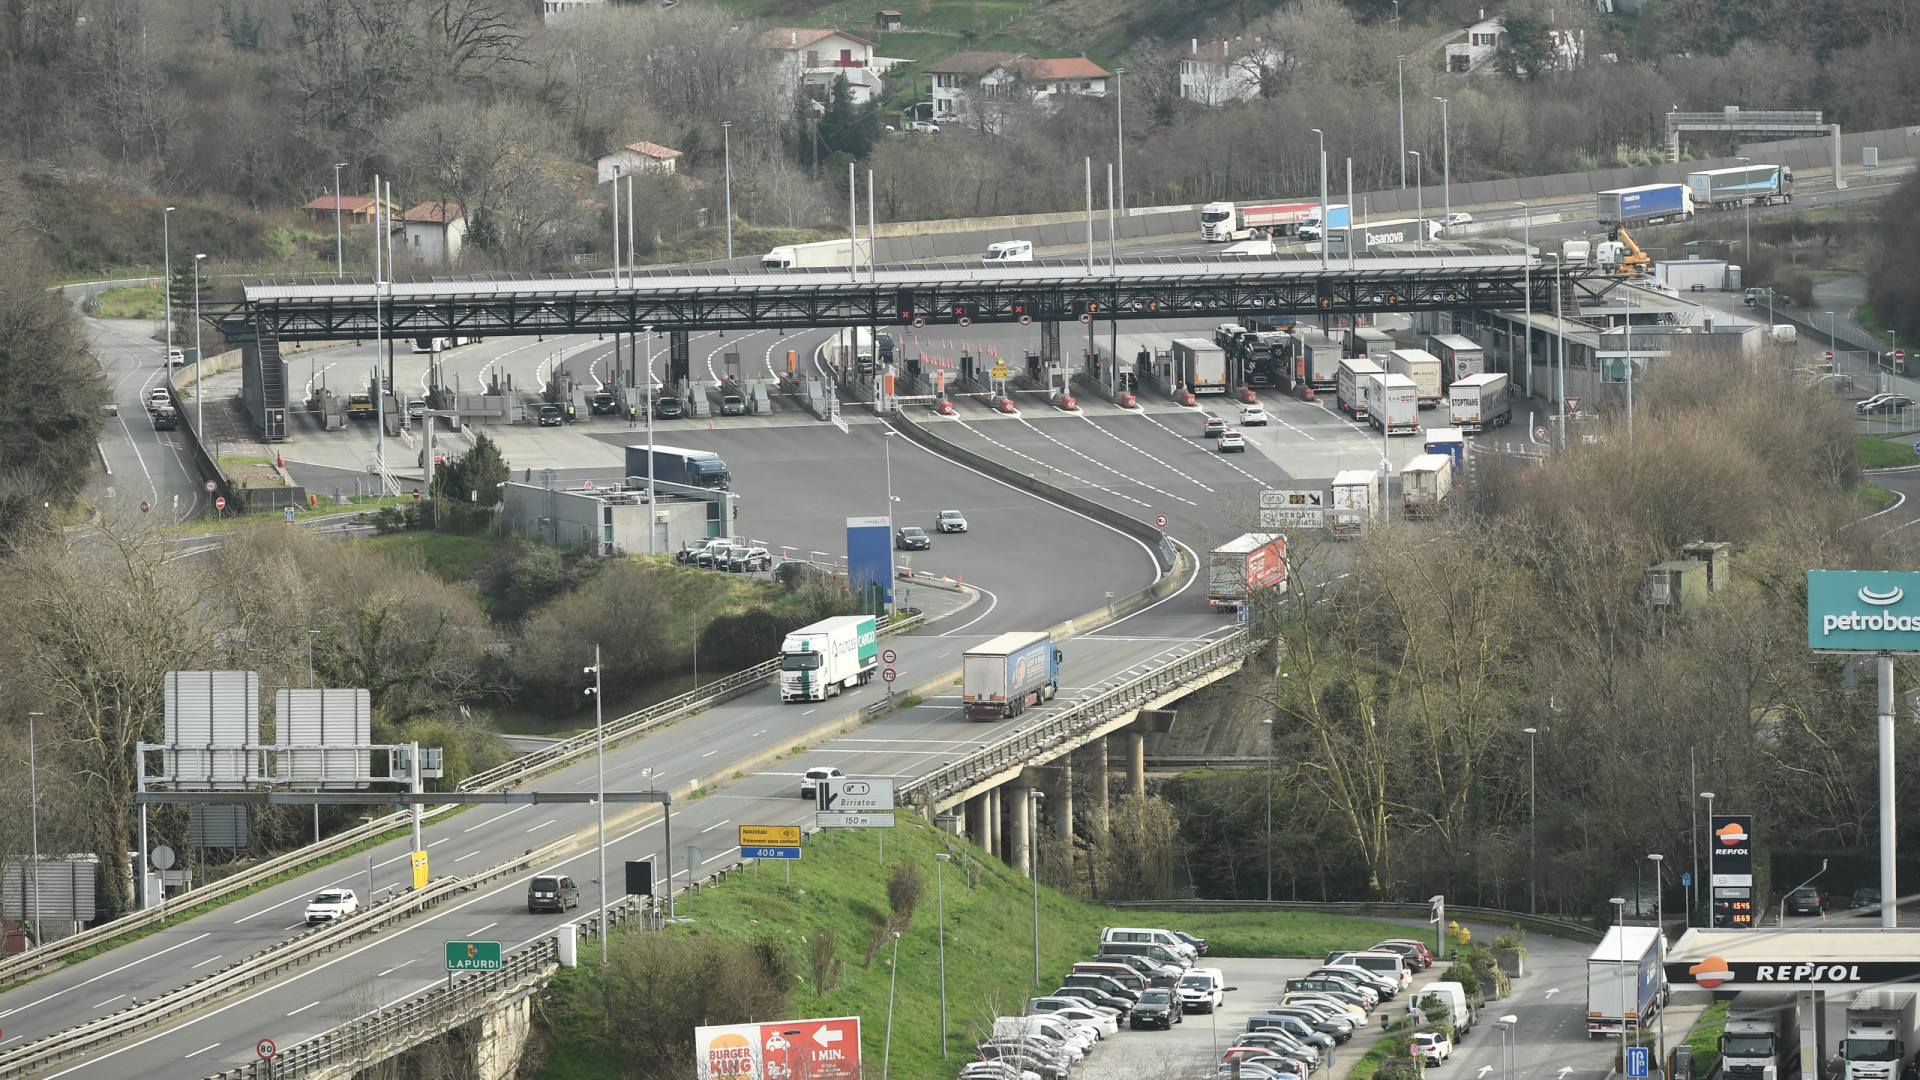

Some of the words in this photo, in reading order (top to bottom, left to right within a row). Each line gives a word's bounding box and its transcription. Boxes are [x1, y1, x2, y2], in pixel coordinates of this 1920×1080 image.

[1366, 231, 1404, 246] Casanova
[1451, 398, 1478, 407] STOPTRANS
[857, 630, 875, 648] CARGO
[845, 817, 859, 825] 150
[756, 848, 775, 857] 400
[448, 959, 499, 969] LAPURDI
[1756, 964, 1862, 982] REPSOL
[260, 1045, 273, 1053] 80
[709, 1048, 751, 1060] BURGER
[818, 1049, 846, 1061] MIN.
[710, 1058, 752, 1074] KING
